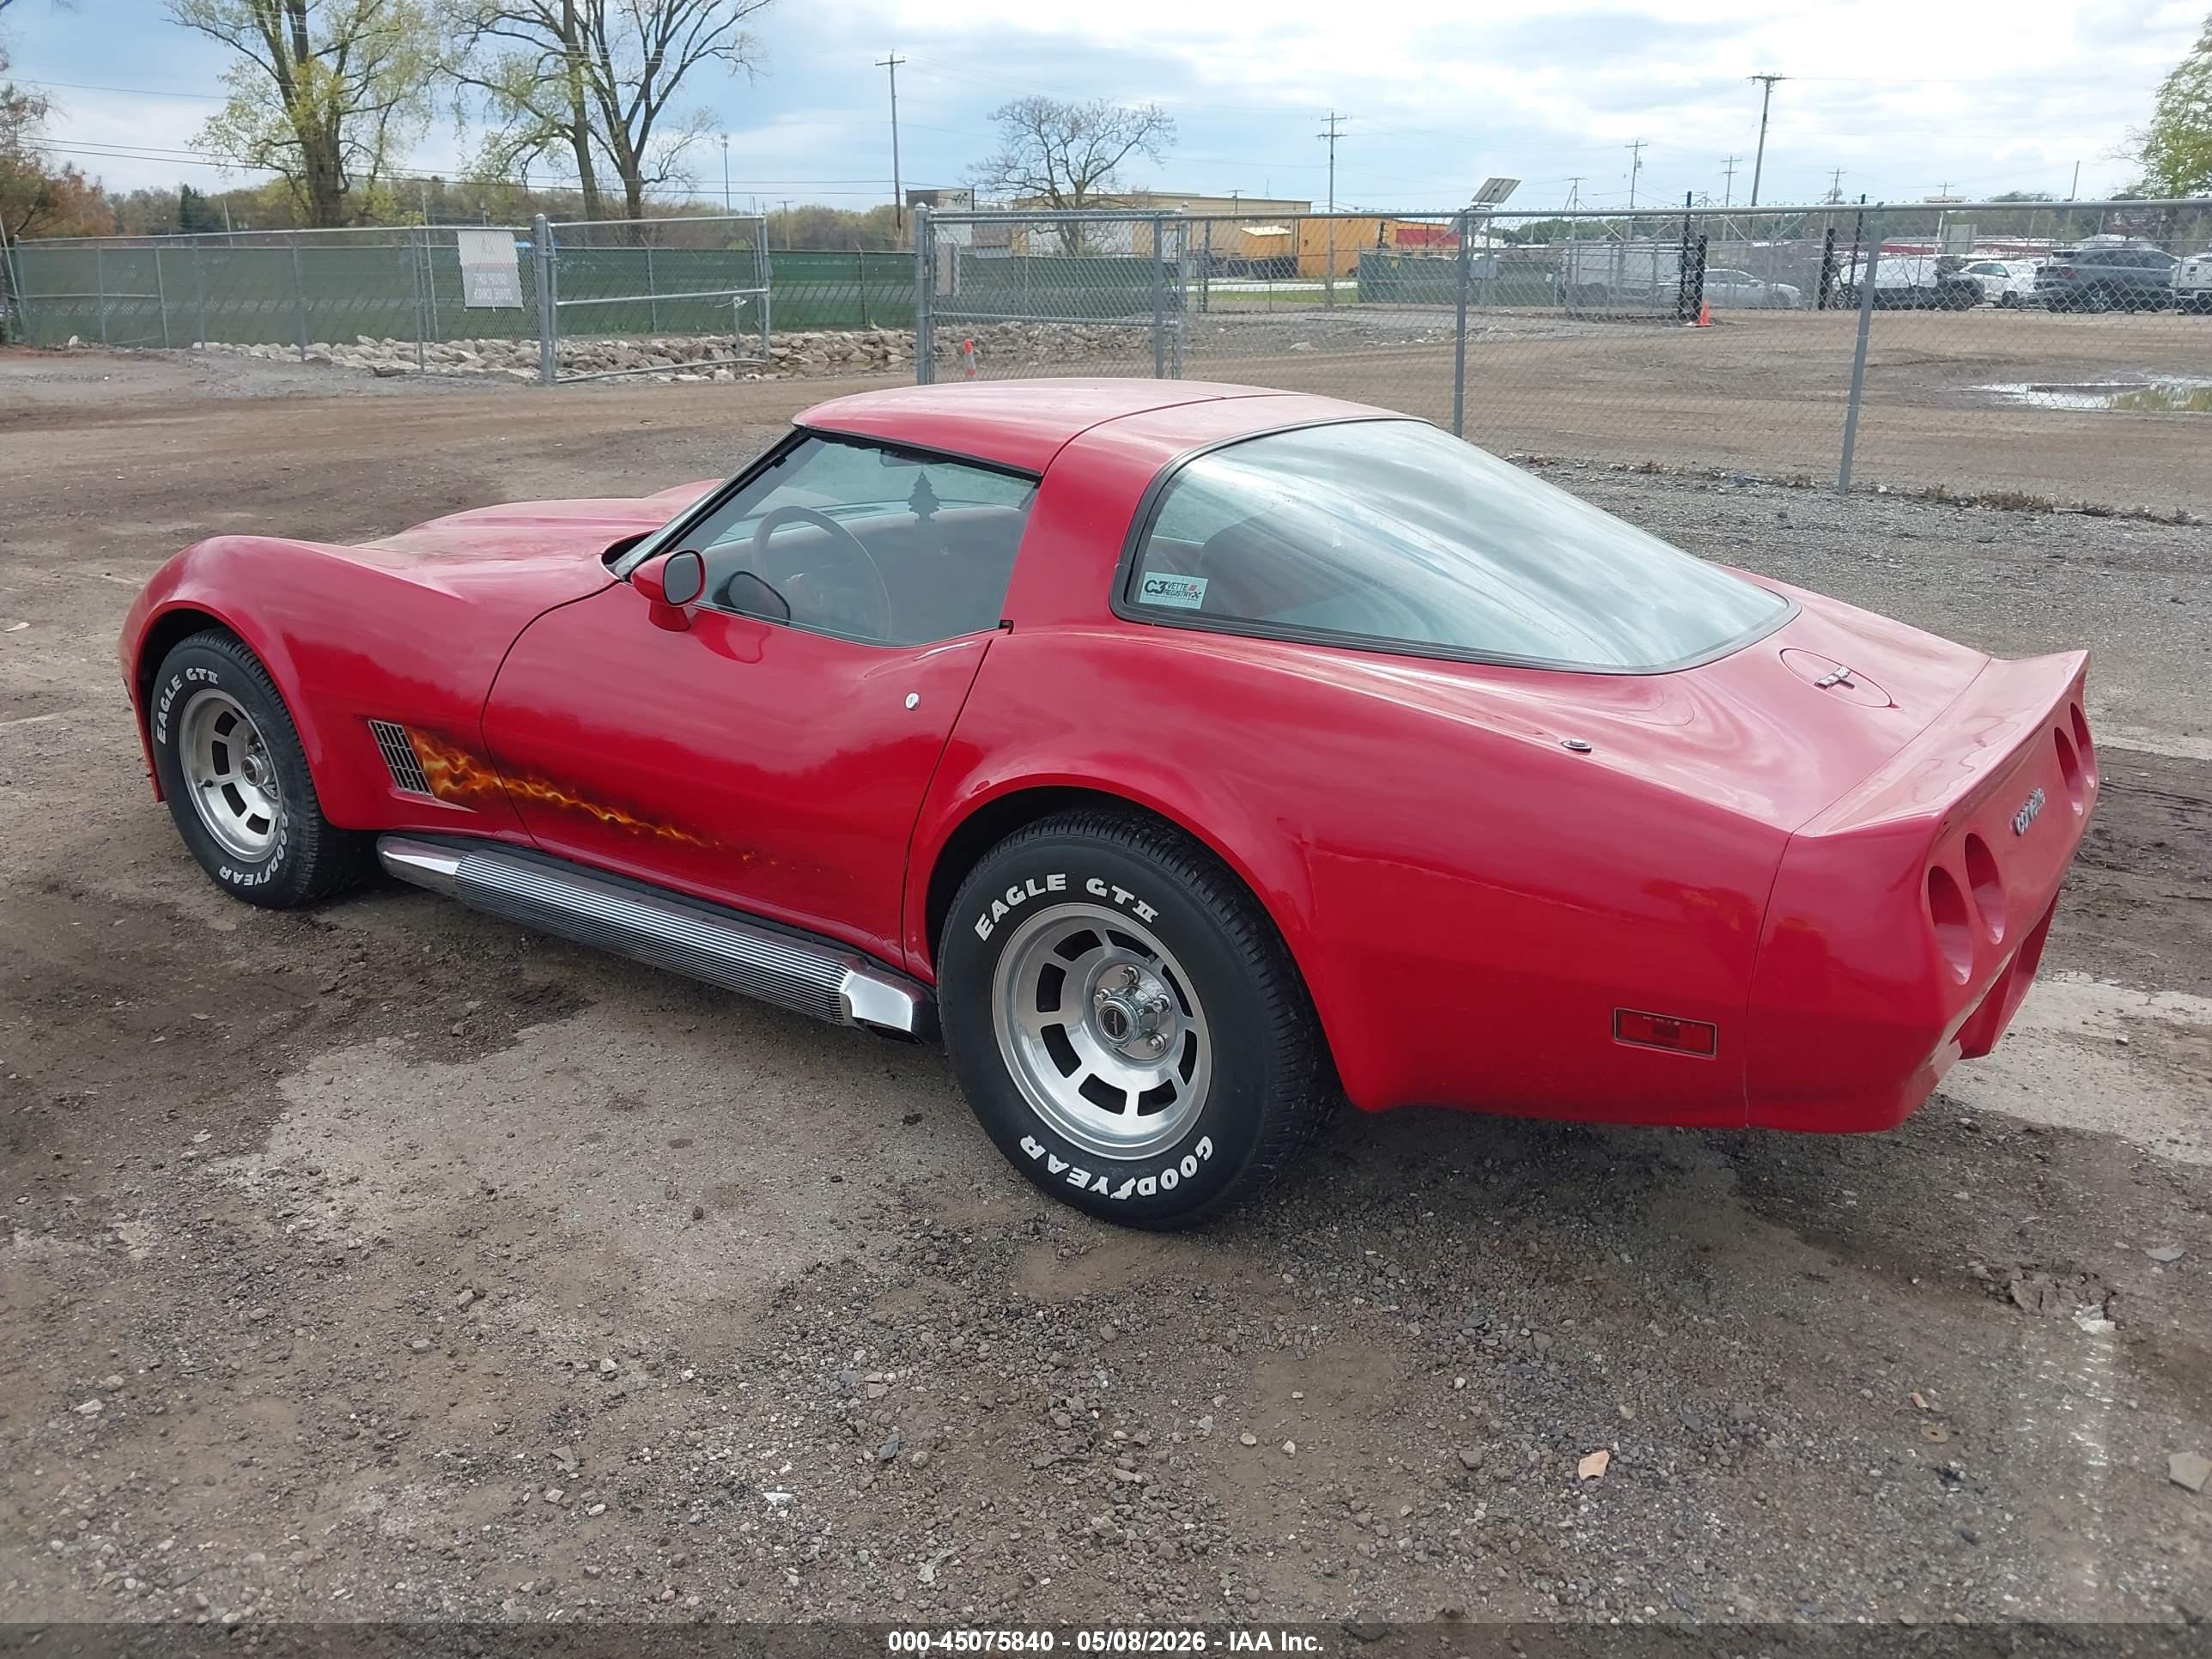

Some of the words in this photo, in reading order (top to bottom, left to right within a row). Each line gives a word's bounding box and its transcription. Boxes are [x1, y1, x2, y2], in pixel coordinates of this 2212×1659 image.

[1145, 580, 1168, 594] C3
[1167, 581, 1188, 591] VETTE
[1164, 589, 1193, 599] REGISTRY
[156, 673, 183, 744] EAGLE
[219, 811, 289, 886] GOODYEAR
[975, 873, 1066, 942] EAGLE
[1019, 1135, 1213, 1200] GOODYEAR
